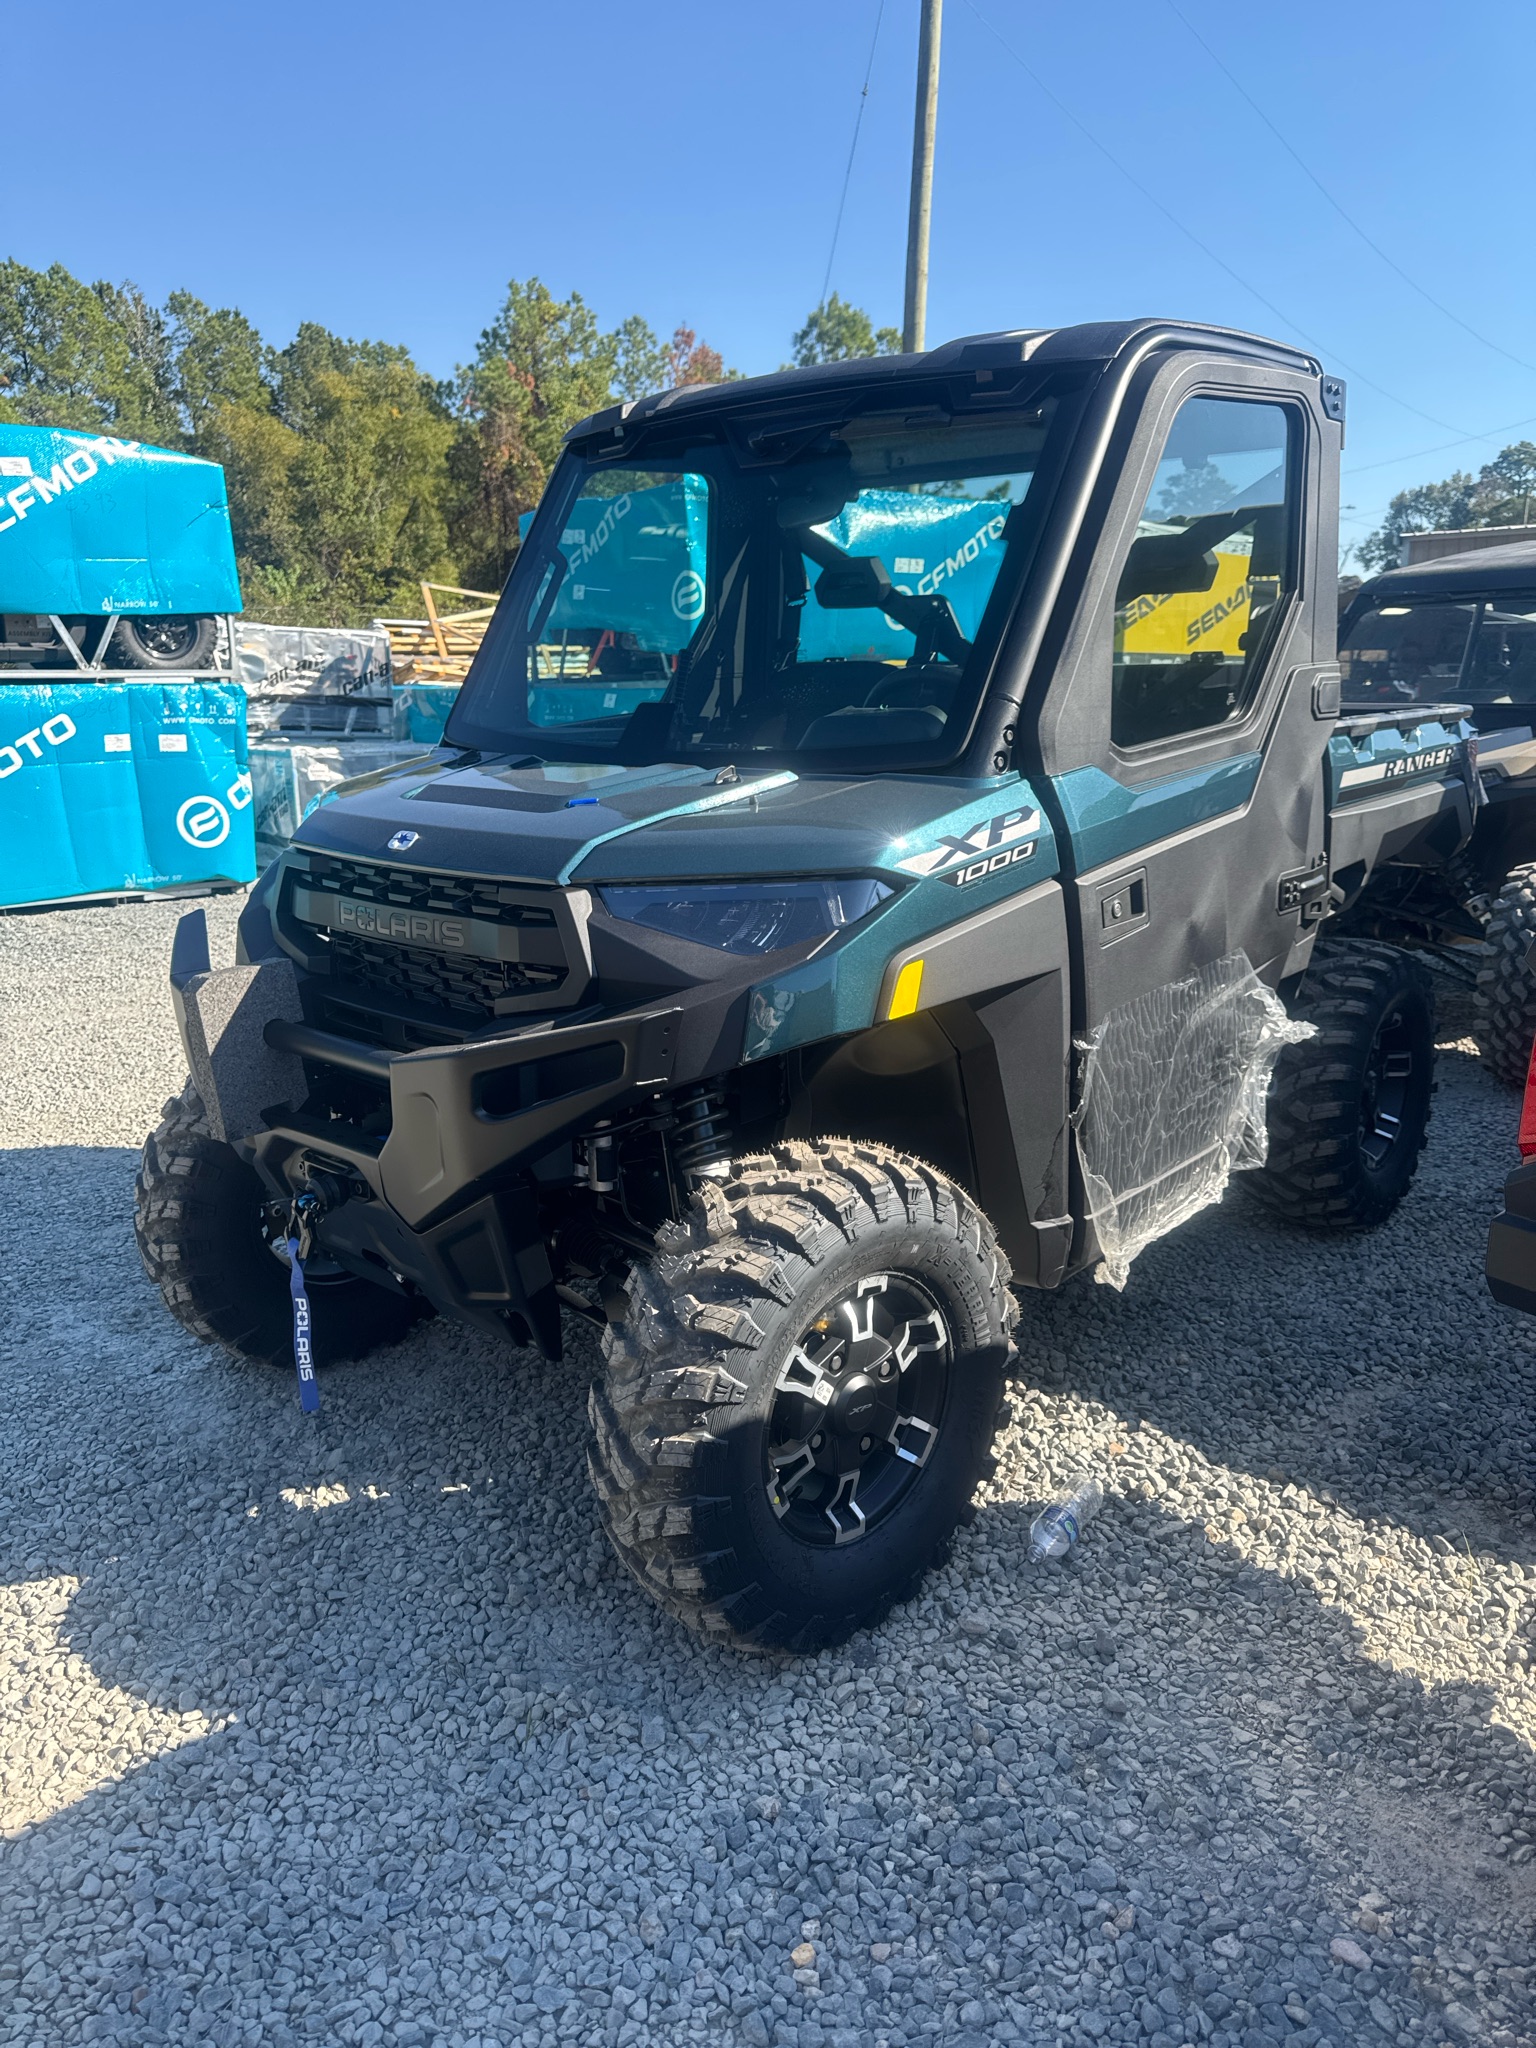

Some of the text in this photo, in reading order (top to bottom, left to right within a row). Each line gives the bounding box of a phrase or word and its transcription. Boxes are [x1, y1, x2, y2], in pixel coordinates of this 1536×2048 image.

[562, 493, 632, 585] FMOTO
[1384, 746, 1455, 778] RANGER
[927, 805, 1035, 873] XP
[956, 841, 1034, 886] 1000
[339, 901, 465, 948] POLARIS
[295, 1297, 313, 1382] POLARIS
